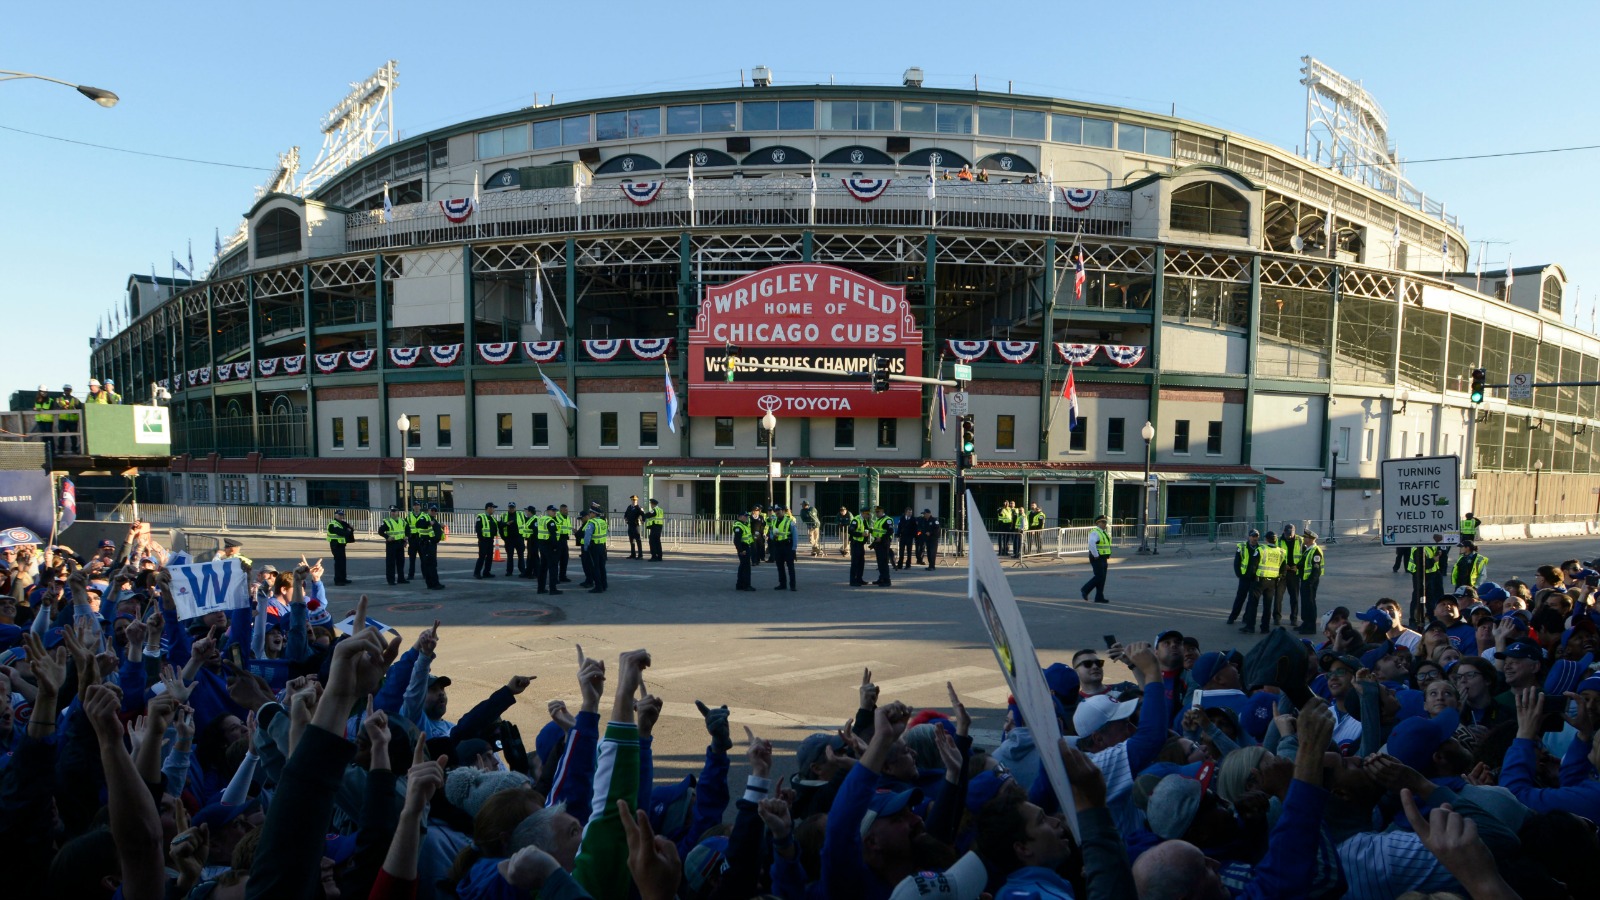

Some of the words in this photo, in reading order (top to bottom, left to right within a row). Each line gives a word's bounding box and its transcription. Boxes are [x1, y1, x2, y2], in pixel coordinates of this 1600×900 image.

[713, 273, 819, 314] WRIGLEY
[829, 275, 897, 314] FIELD
[764, 303, 813, 315] HOME
[824, 303, 847, 315] OF
[713, 323, 820, 342] CHICAGO
[831, 324, 897, 342] CUBS
[763, 356, 810, 372] SERIES
[814, 357, 905, 373] CHAMPINS
[785, 397, 851, 411] TOYOTA
[1397, 467, 1441, 477] TURNING
[1399, 480, 1440, 490] TRAFFIC
[1400, 493, 1438, 507] MUST
[1396, 511, 1426, 520] YIELD
[1431, 510, 1444, 519] TO
[1386, 523, 1454, 534] PEDESTRIANS
[181, 561, 233, 608] W
